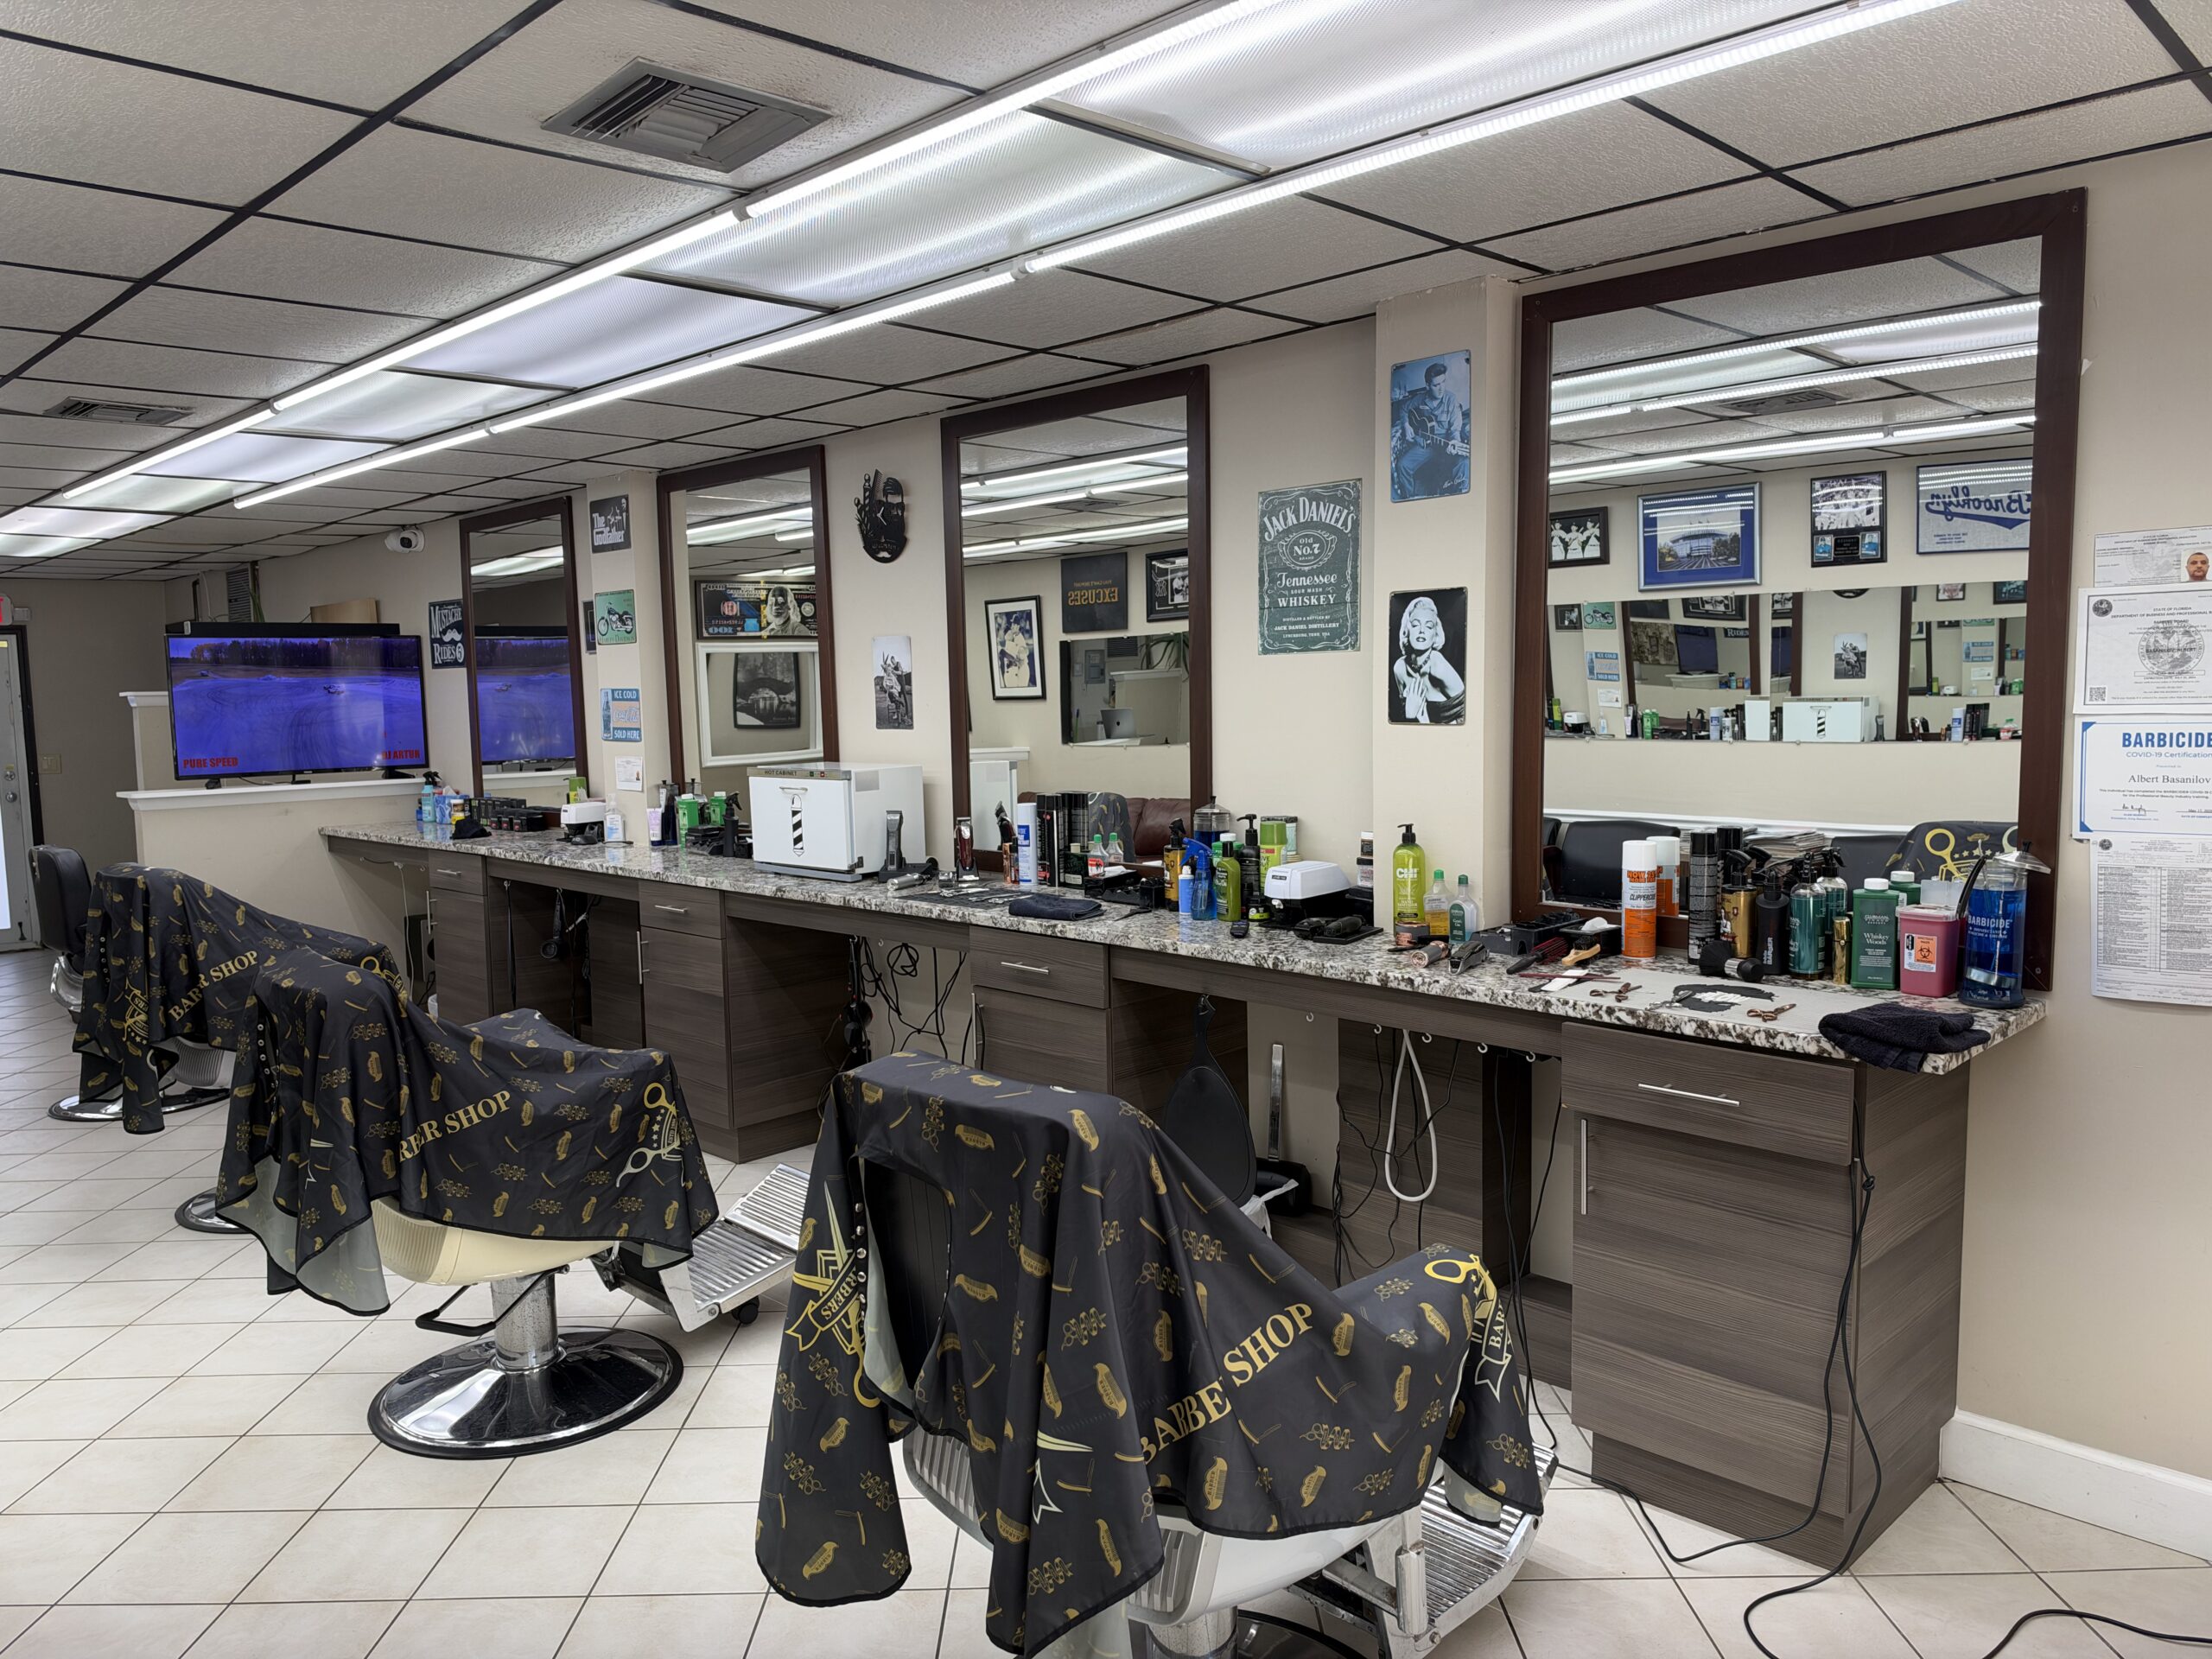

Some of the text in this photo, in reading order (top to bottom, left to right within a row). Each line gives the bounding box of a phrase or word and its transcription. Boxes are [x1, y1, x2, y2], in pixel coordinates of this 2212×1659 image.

[592, 512, 606, 528] The
[1263, 497, 1356, 542] JACK DANIEL'S
[594, 526, 625, 545] Godfather
[1276, 572, 1338, 588] Tennessee
[1278, 594, 1337, 607] WHISKEY
[430, 605, 462, 639] MUSTACHE
[433, 643, 456, 664] RIDES
[623, 690, 637, 699] COLD
[613, 729, 639, 739] SOLD HERE
[2122, 732, 2212, 748] BARBICIDE
[182, 757, 238, 768] PURE SPEED
[2128, 774, 2211, 784] Albert Basanilov
[1395, 868, 1417, 879] CHI
[1626, 870, 1646, 879] NOW
[1967, 915, 2011, 929] BARBICIDE
[209, 950, 258, 982] SHOP
[444, 1090, 511, 1135] SHOP
[1223, 1302, 1314, 1388] SHOP
